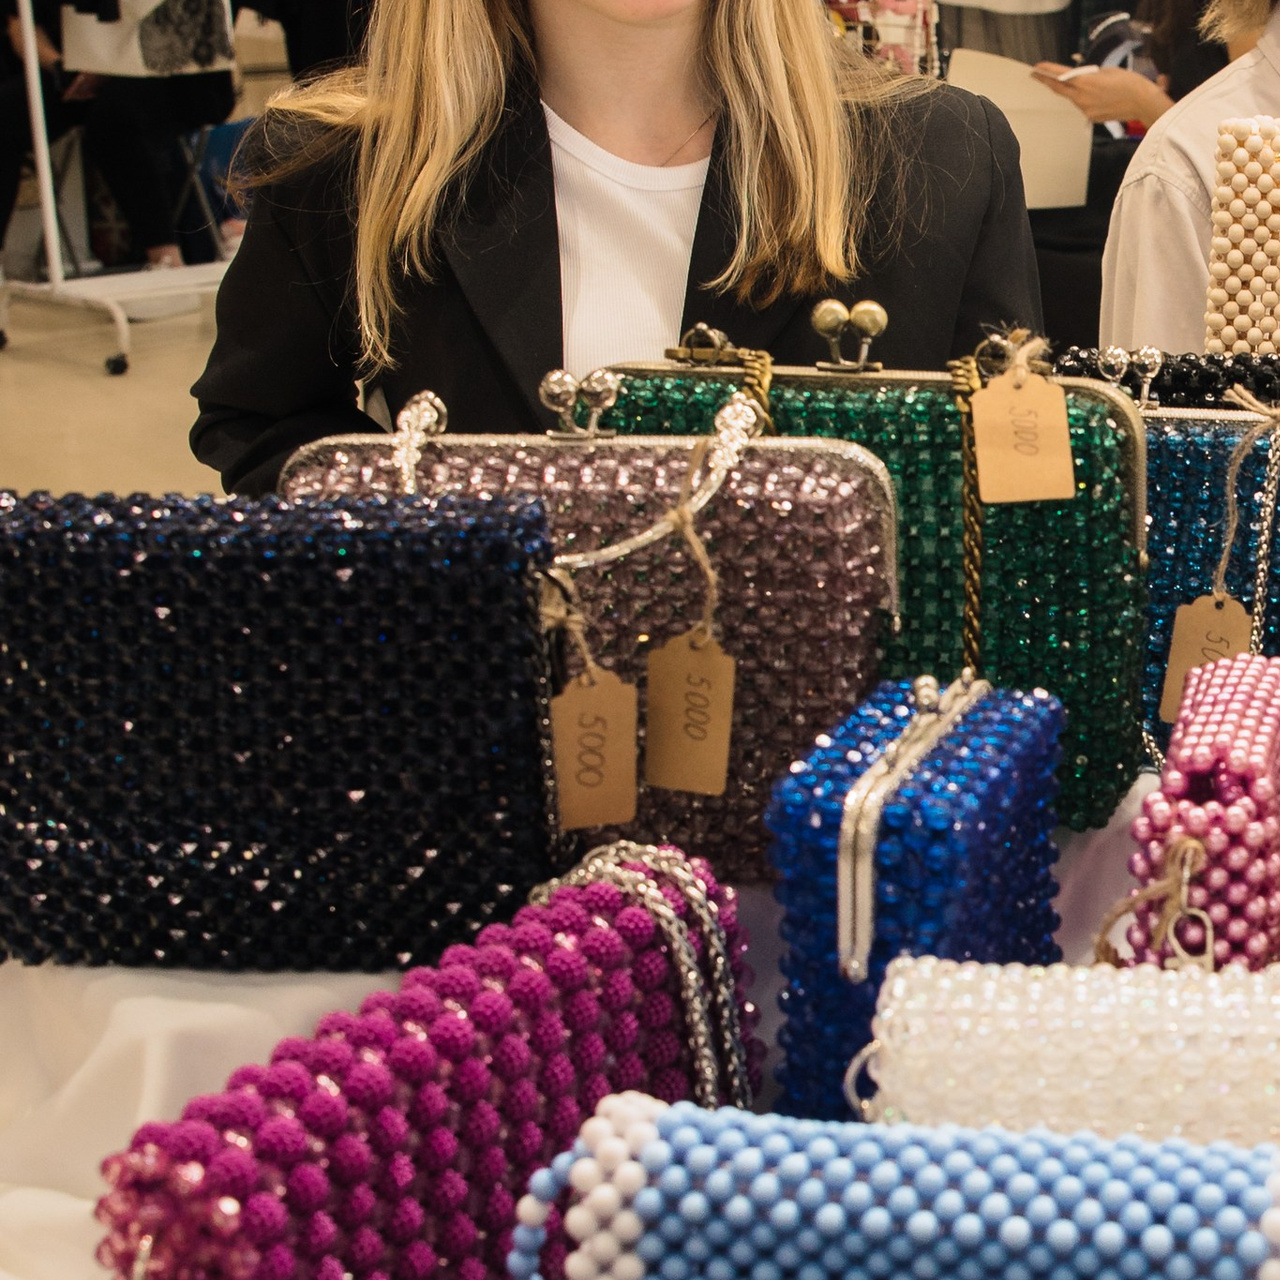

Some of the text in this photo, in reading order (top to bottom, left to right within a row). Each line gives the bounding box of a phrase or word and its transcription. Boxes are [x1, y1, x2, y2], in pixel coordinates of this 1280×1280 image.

[1008, 405, 1040, 457] 5000
[682, 672, 713, 742] 5000
[574, 711, 609, 789] 5000
